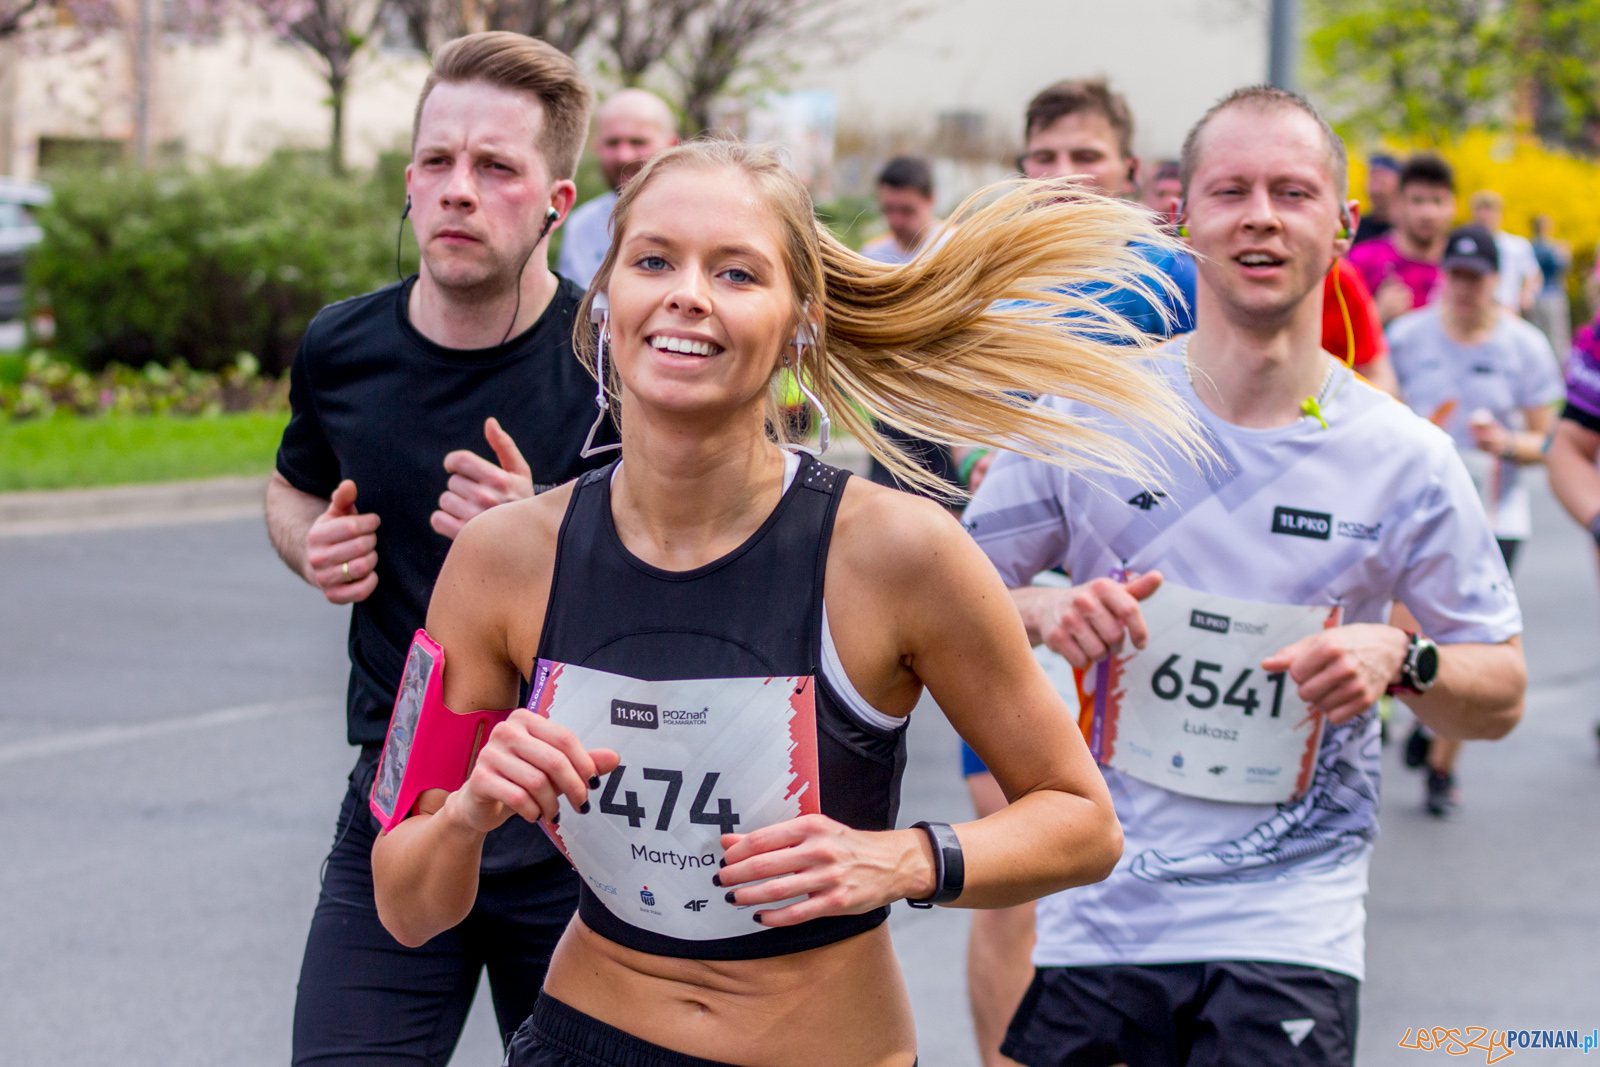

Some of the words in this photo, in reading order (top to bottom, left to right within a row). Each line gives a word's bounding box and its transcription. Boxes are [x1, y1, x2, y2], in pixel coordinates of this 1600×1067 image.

[1280, 513, 1328, 533] 11.PKO
[1151, 653, 1287, 718] 6541
[616, 707, 654, 722] 11.PKO
[1183, 719, 1239, 742] Łukasz
[599, 765, 740, 835] 474
[631, 843, 716, 870] Martyna
[684, 899, 709, 912] 4F
